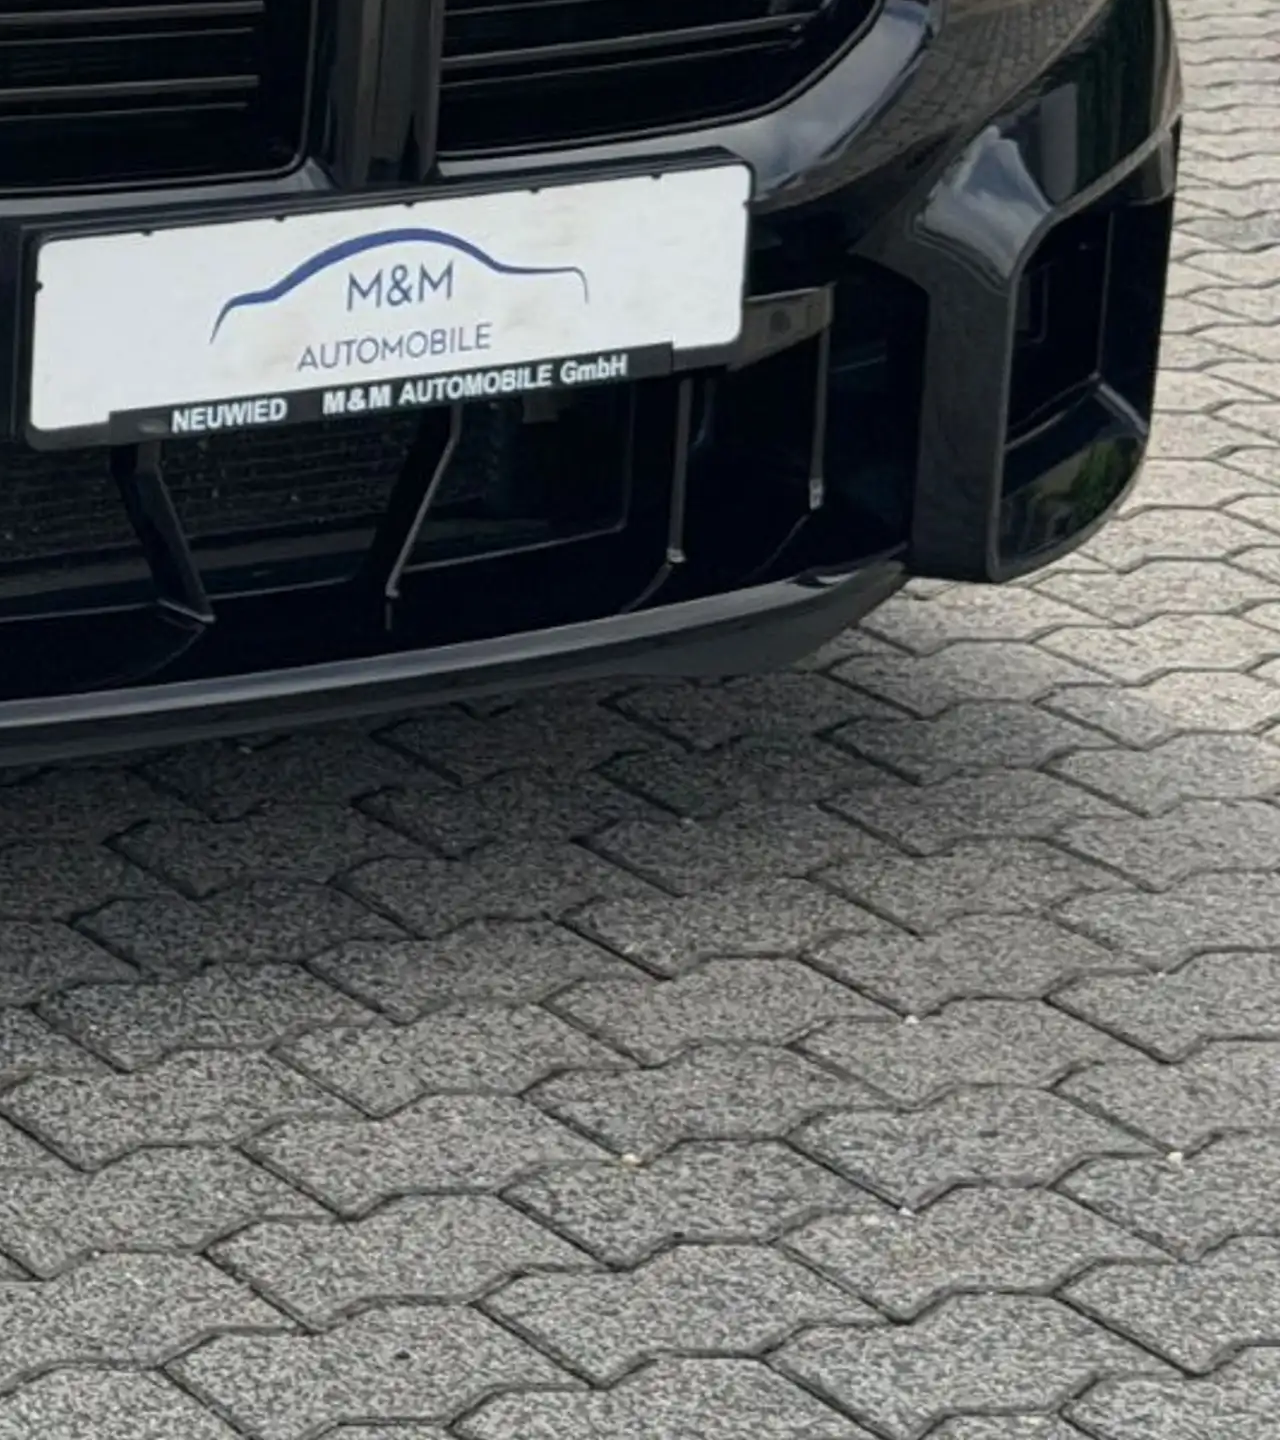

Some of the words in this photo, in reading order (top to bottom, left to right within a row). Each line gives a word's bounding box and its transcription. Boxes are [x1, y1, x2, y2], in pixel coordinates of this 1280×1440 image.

[347, 261, 453, 311] M&M
[297, 323, 492, 371] AUTOMOBILE
[171, 398, 287, 433] NEUWIED
[322, 384, 391, 416] M&M
[398, 364, 553, 406] AUTOMOBILE
[560, 354, 628, 384] GmbH
